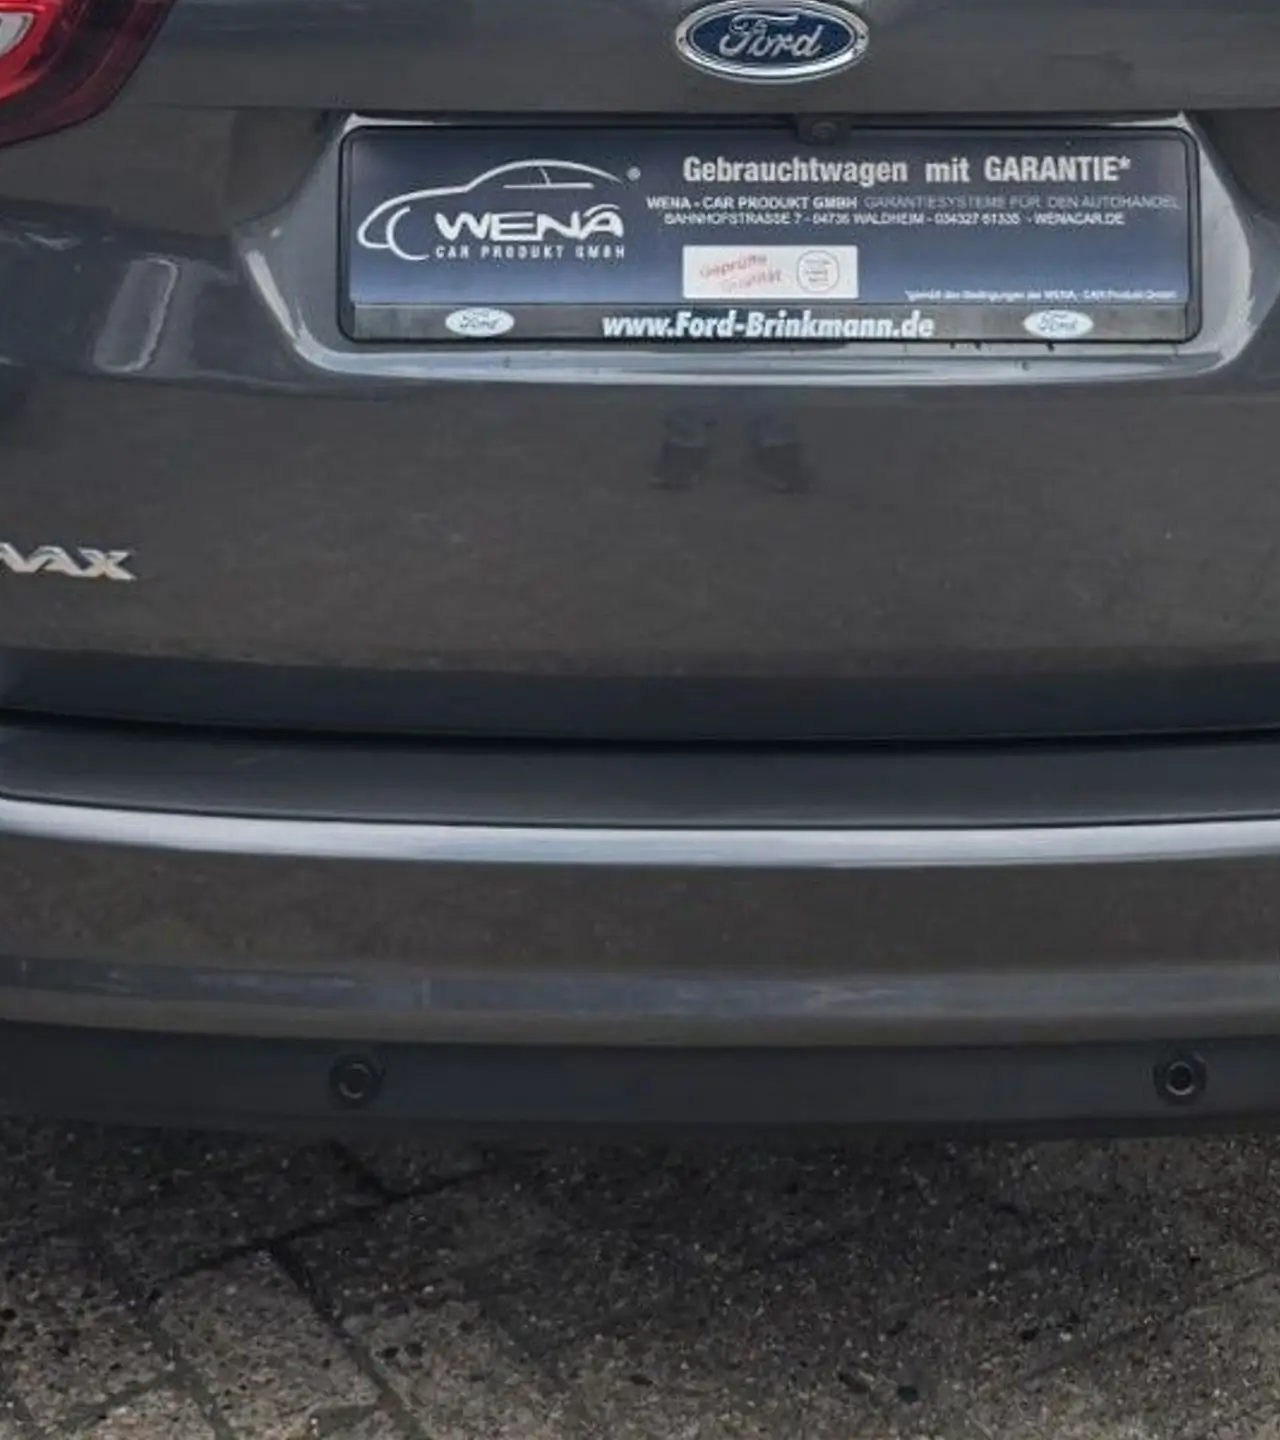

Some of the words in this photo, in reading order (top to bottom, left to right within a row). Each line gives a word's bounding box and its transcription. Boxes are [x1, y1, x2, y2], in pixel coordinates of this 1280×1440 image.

[719, 13, 824, 58] Ford
[682, 156, 909, 188] Gebrauchtwagen
[925, 158, 972, 182] mit
[646, 196, 691, 209] WENA
[702, 196, 734, 209] CAR
[738, 196, 808, 209] PRODUKT
[813, 196, 857, 209] GMBH
[435, 204, 624, 241] WENA
[435, 245, 470, 259] CAR
[480, 245, 564, 259] PRODUKT
[575, 245, 626, 259] GMBH
[602, 310, 935, 338] www.Ford-Brinkmann.de
